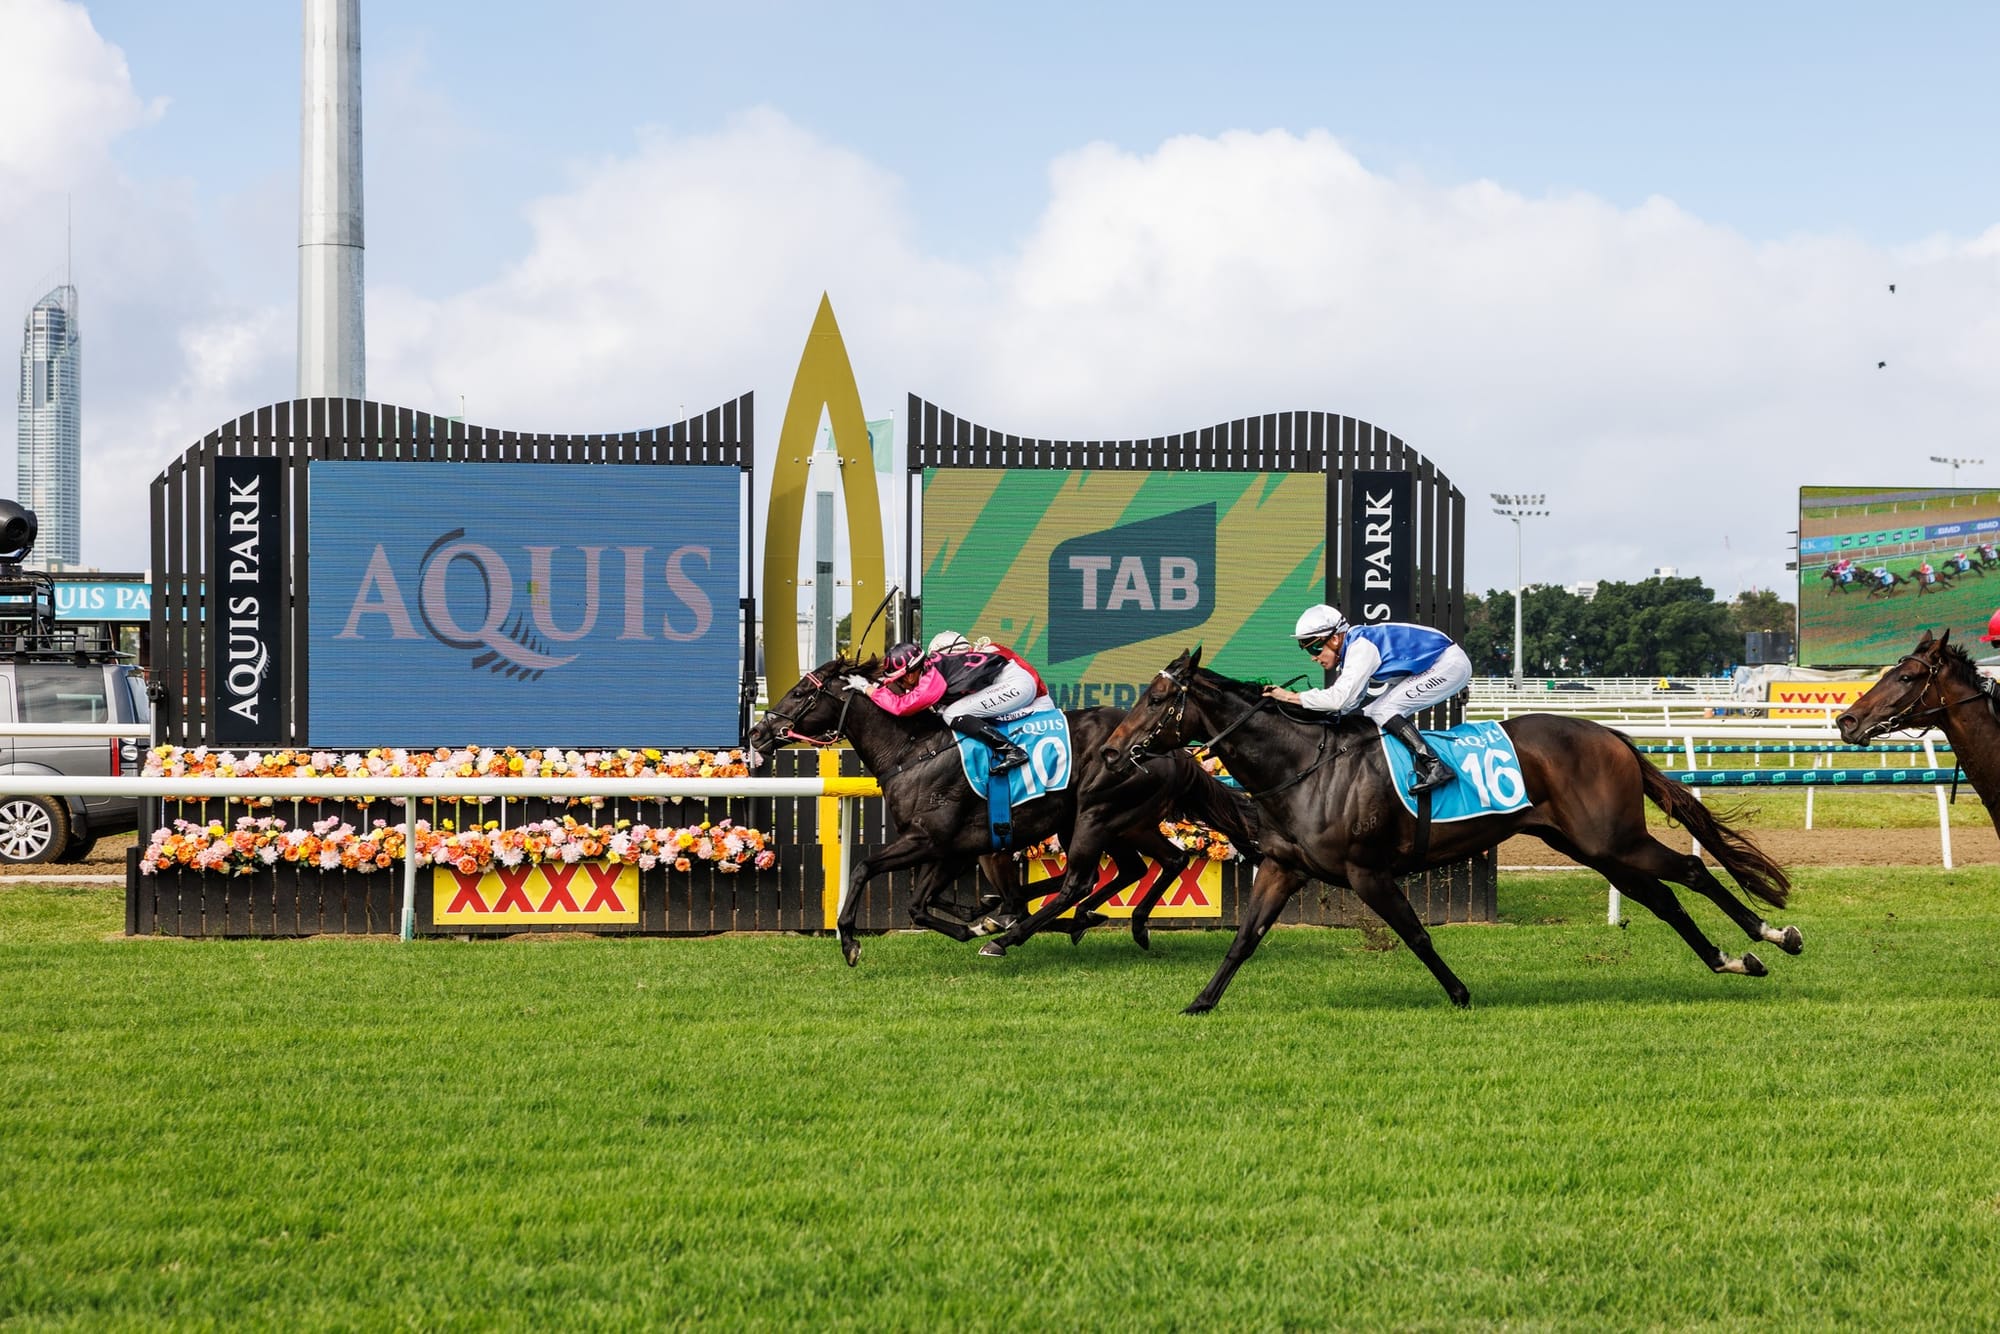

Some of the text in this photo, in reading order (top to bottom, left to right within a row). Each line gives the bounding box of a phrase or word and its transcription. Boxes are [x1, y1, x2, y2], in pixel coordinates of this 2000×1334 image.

[1364, 488, 1393, 591] PARK
[115, 587, 151, 609] PA
[228, 474, 268, 725] AQUIS PARK
[332, 543, 714, 669] AQUIS
[1069, 556, 1200, 610] TAB
[1014, 718, 1064, 738] QUIS
[1017, 736, 1068, 795] 10
[1461, 748, 1526, 808] 16
[446, 862, 627, 913] XXXX
